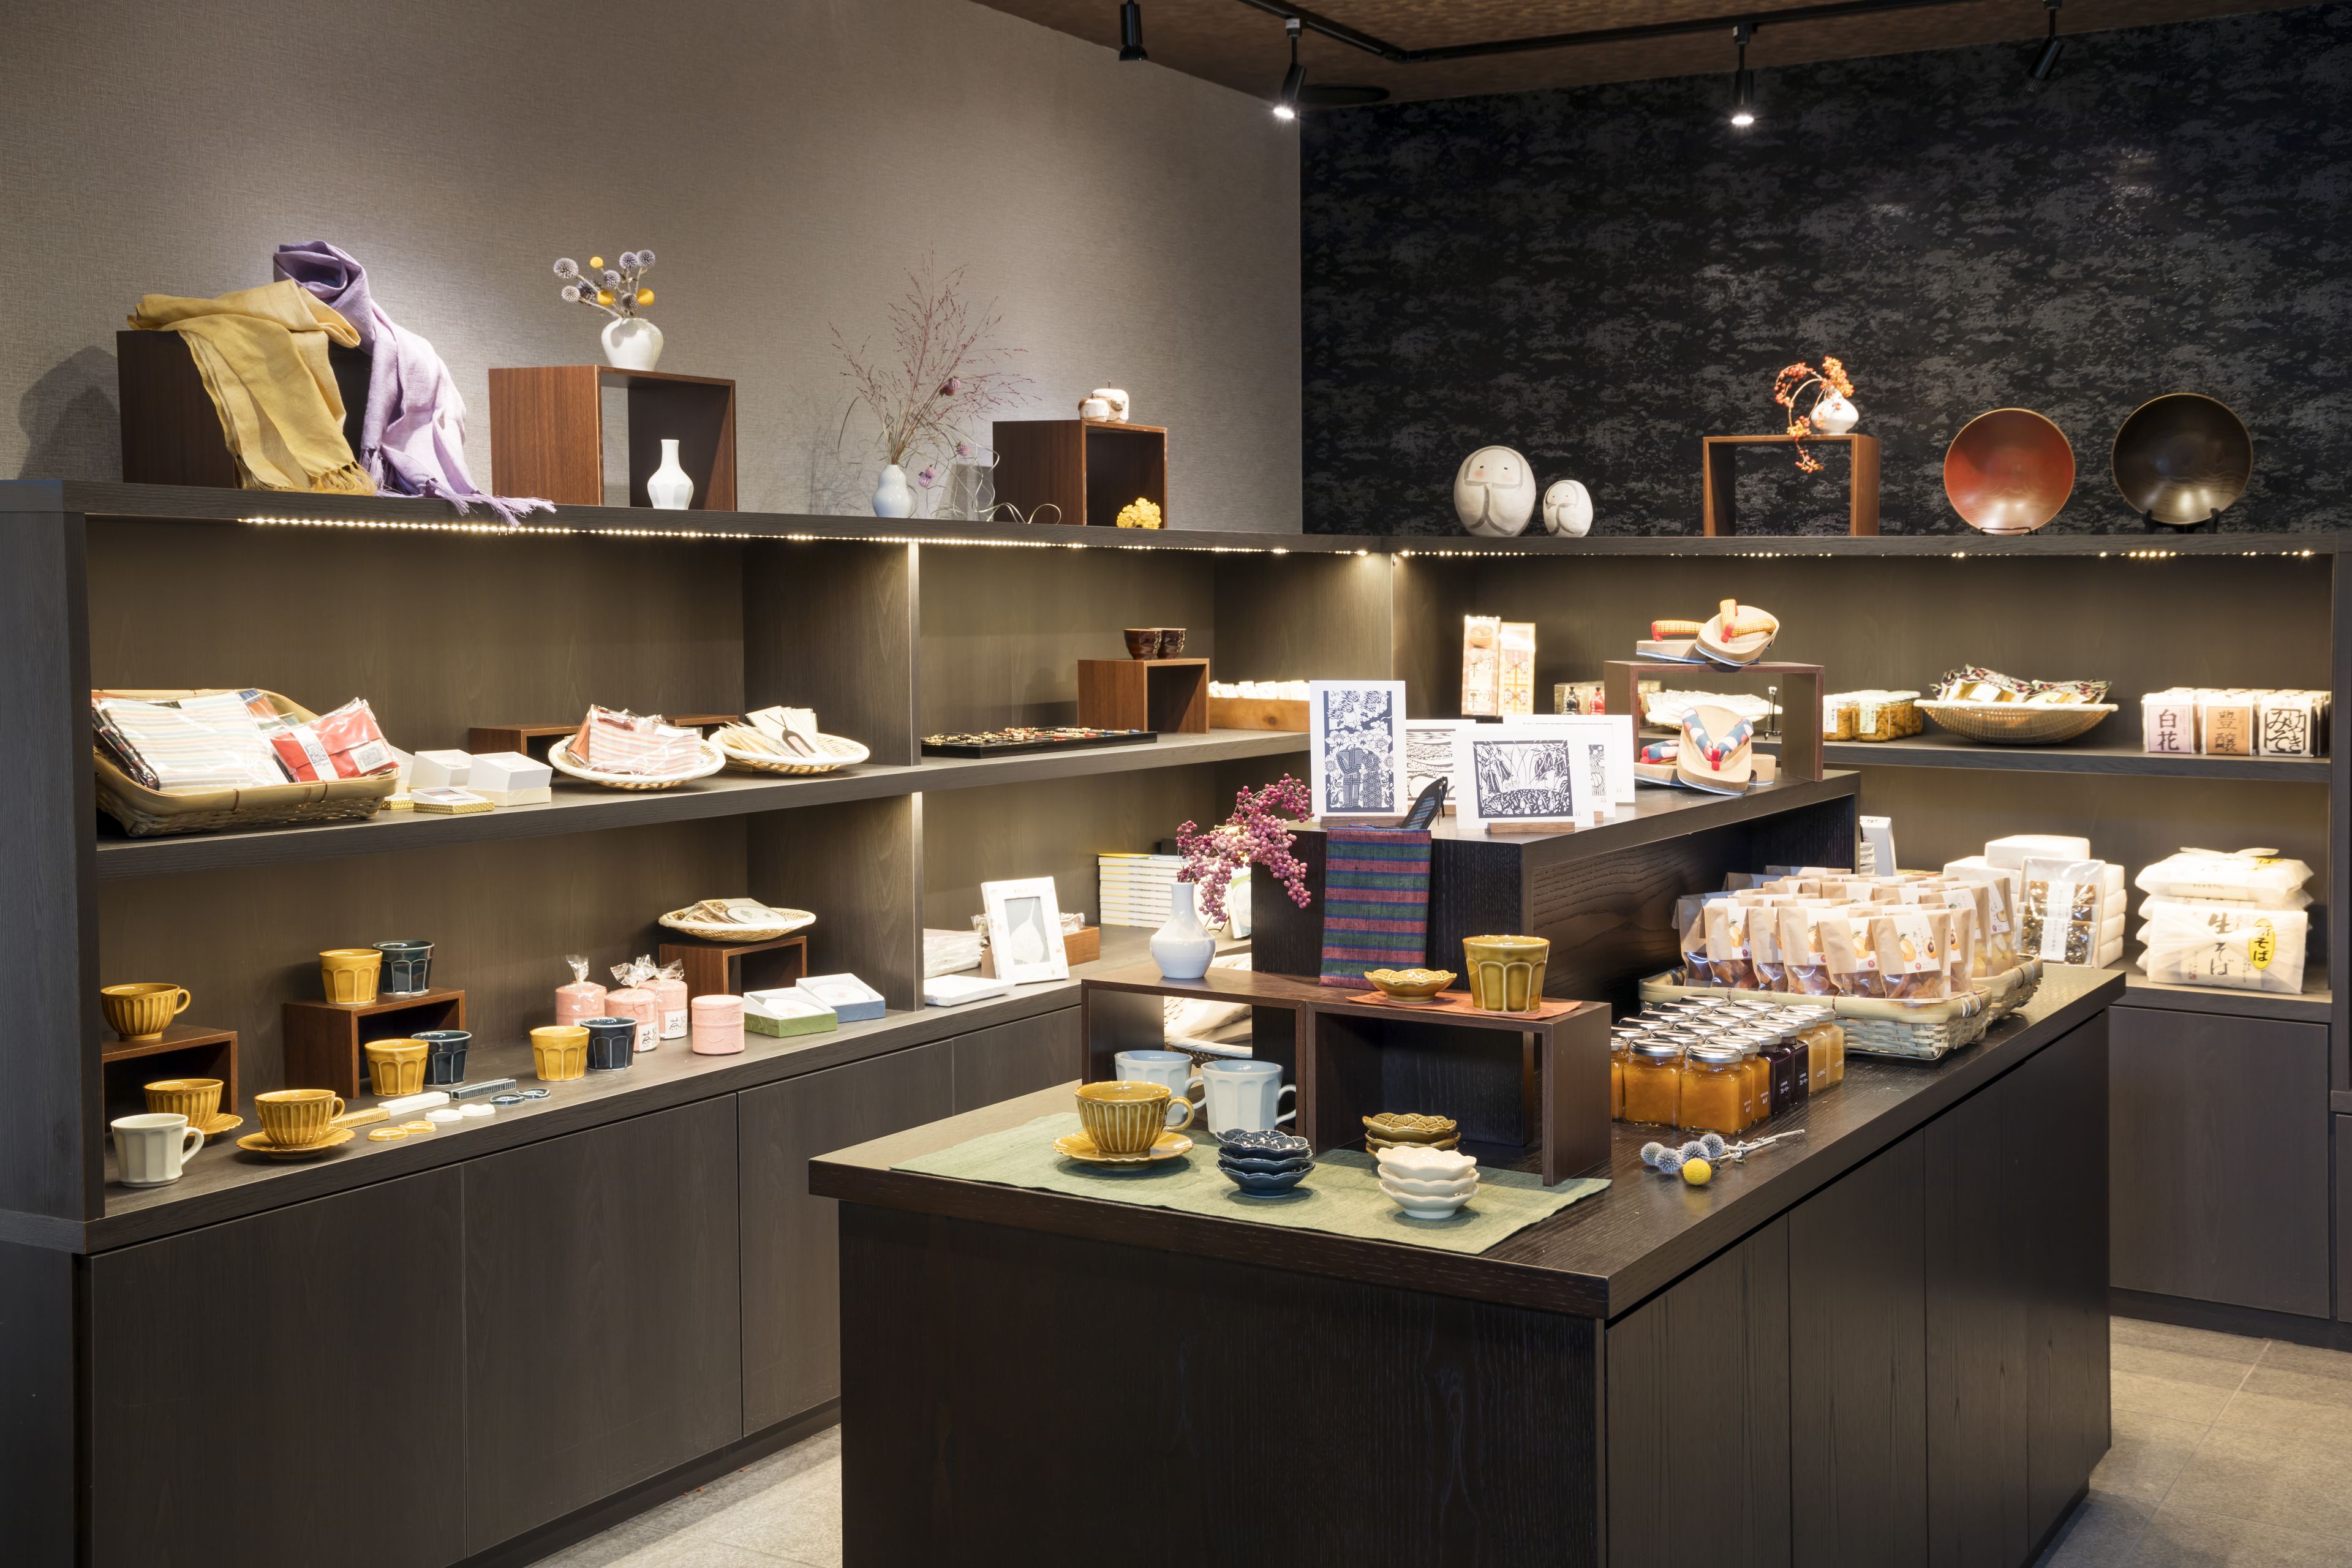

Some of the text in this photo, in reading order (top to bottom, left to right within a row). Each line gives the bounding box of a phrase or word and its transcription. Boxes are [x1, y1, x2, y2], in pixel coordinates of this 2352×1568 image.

[2157, 709, 2180, 751] 白花
[2267, 710, 2289, 751] みそ
[2208, 912, 2234, 975] 生そば
